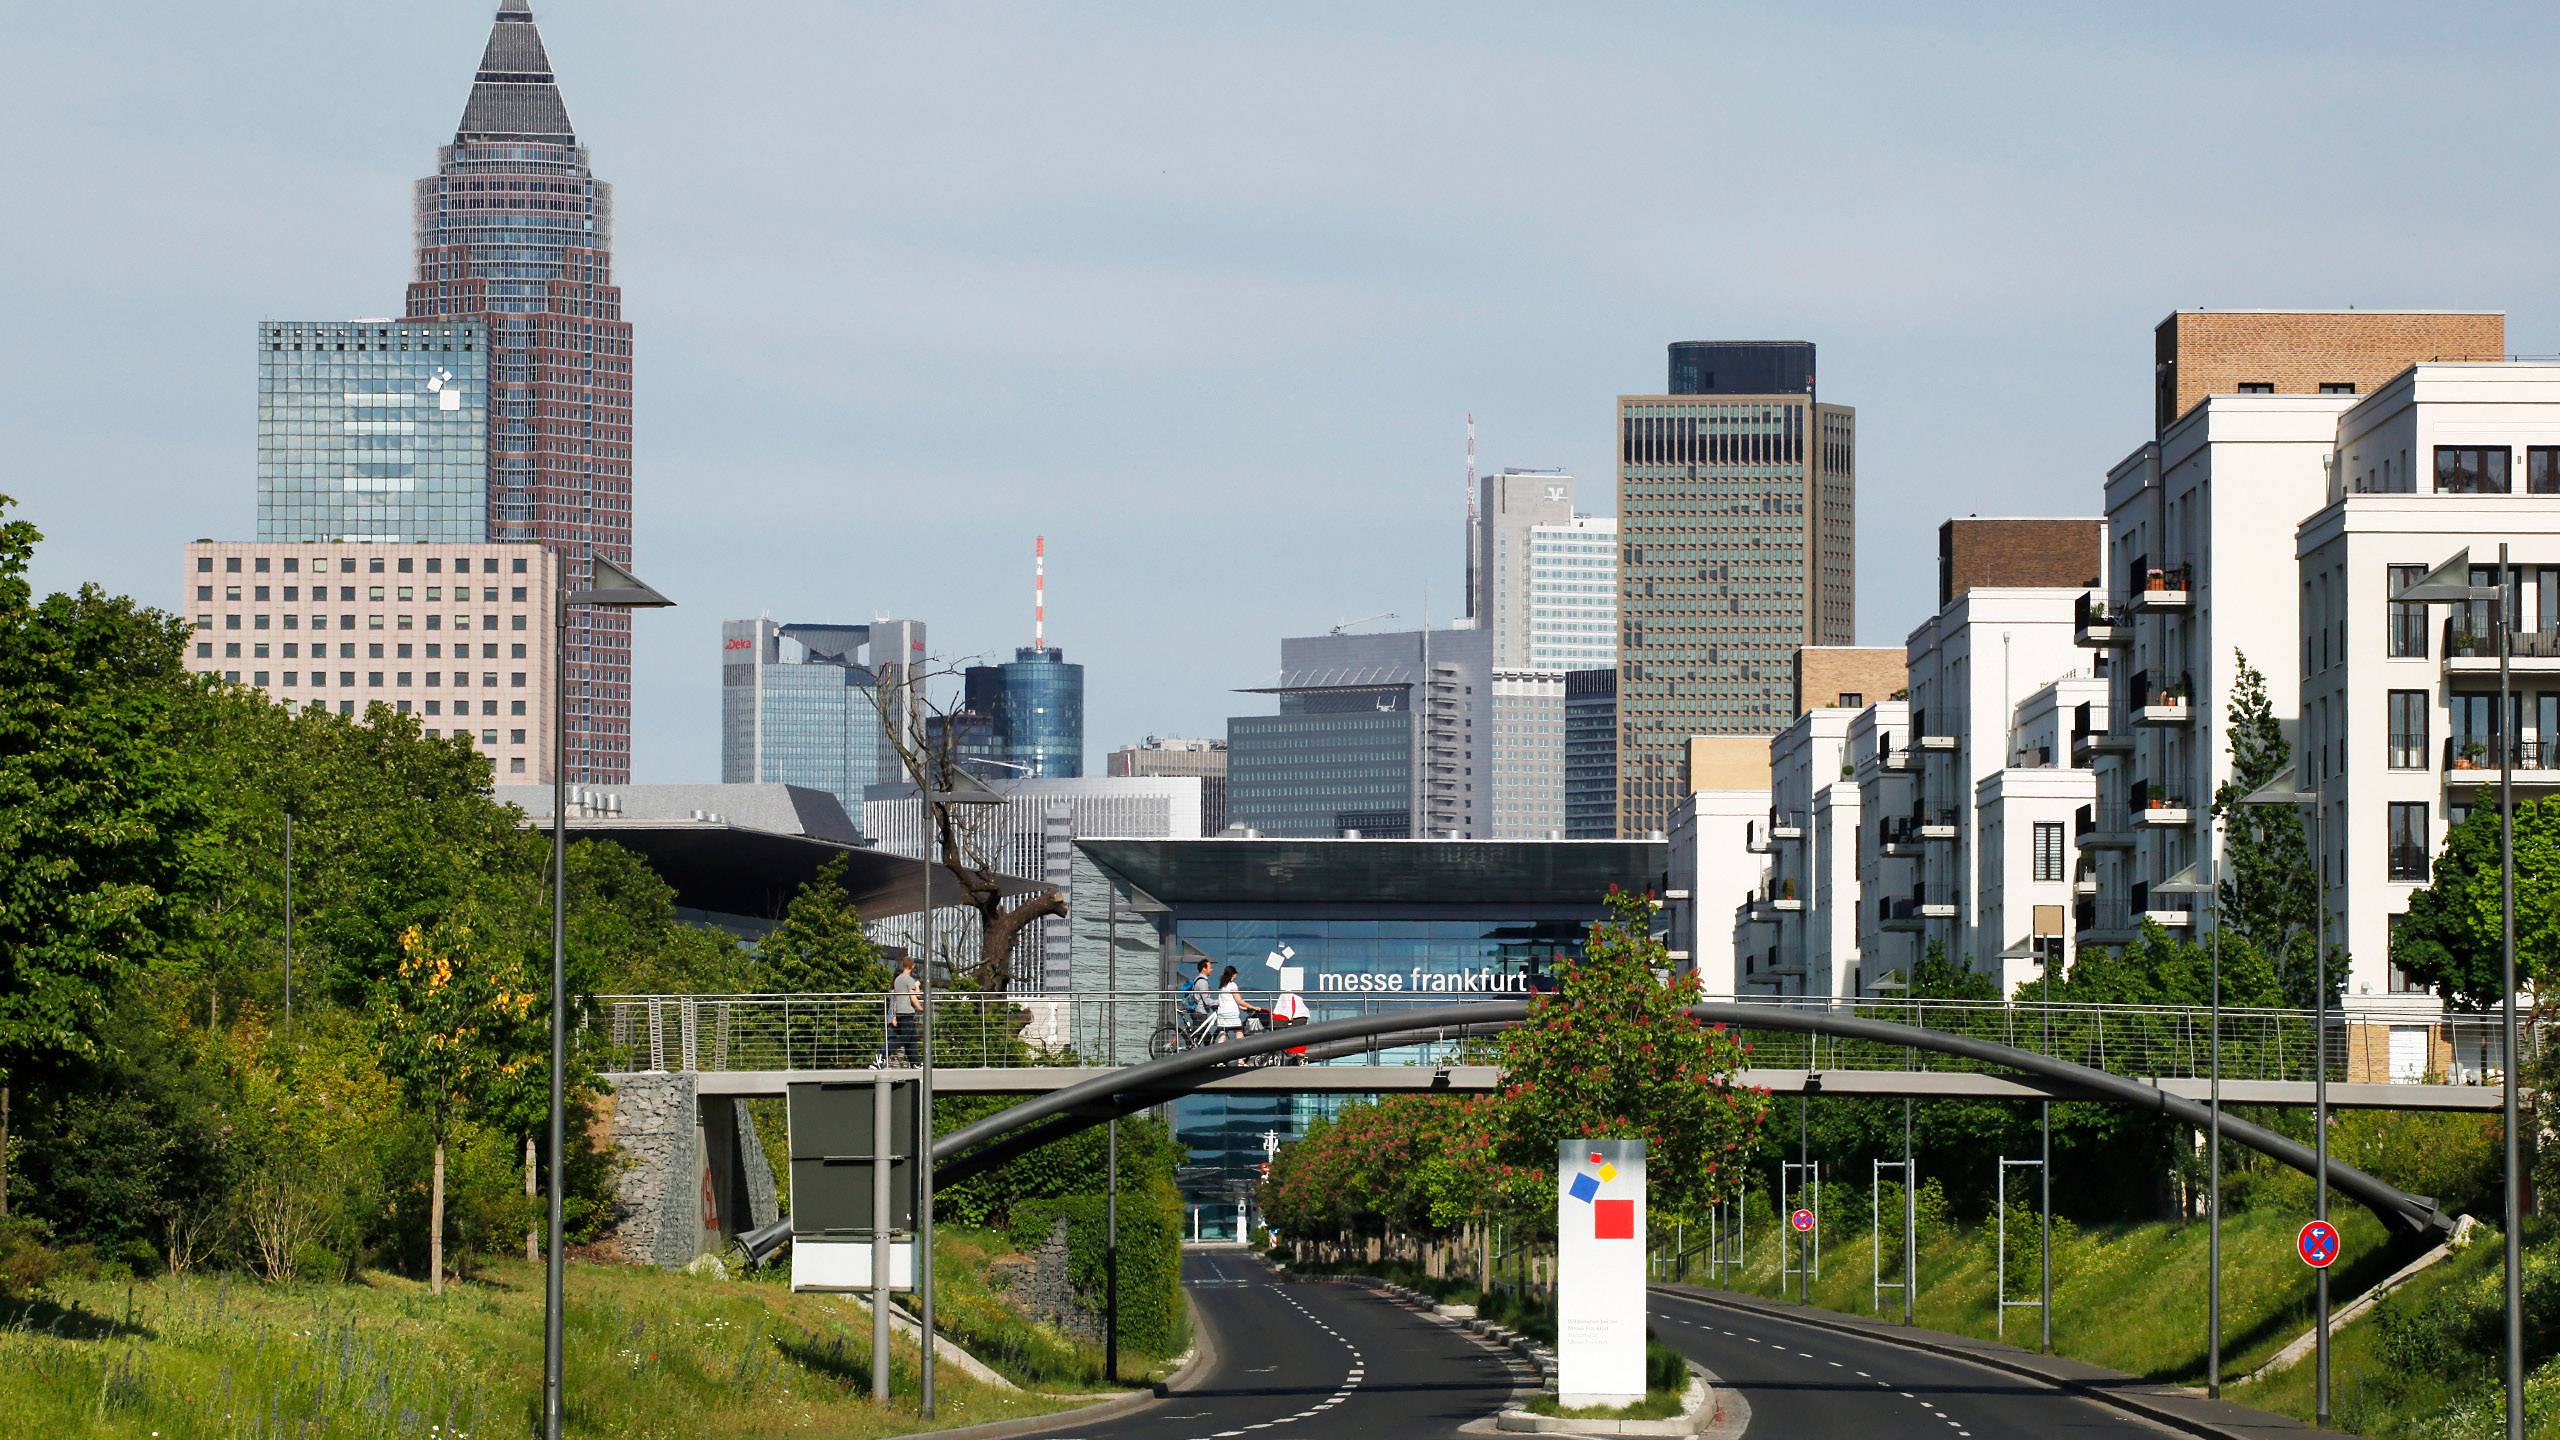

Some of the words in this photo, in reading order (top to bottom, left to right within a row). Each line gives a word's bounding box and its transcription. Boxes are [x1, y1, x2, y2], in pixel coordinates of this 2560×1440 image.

[724, 639, 752, 649] Deka
[1319, 973, 1403, 992] messe
[1410, 968, 1527, 992] frankfurt
